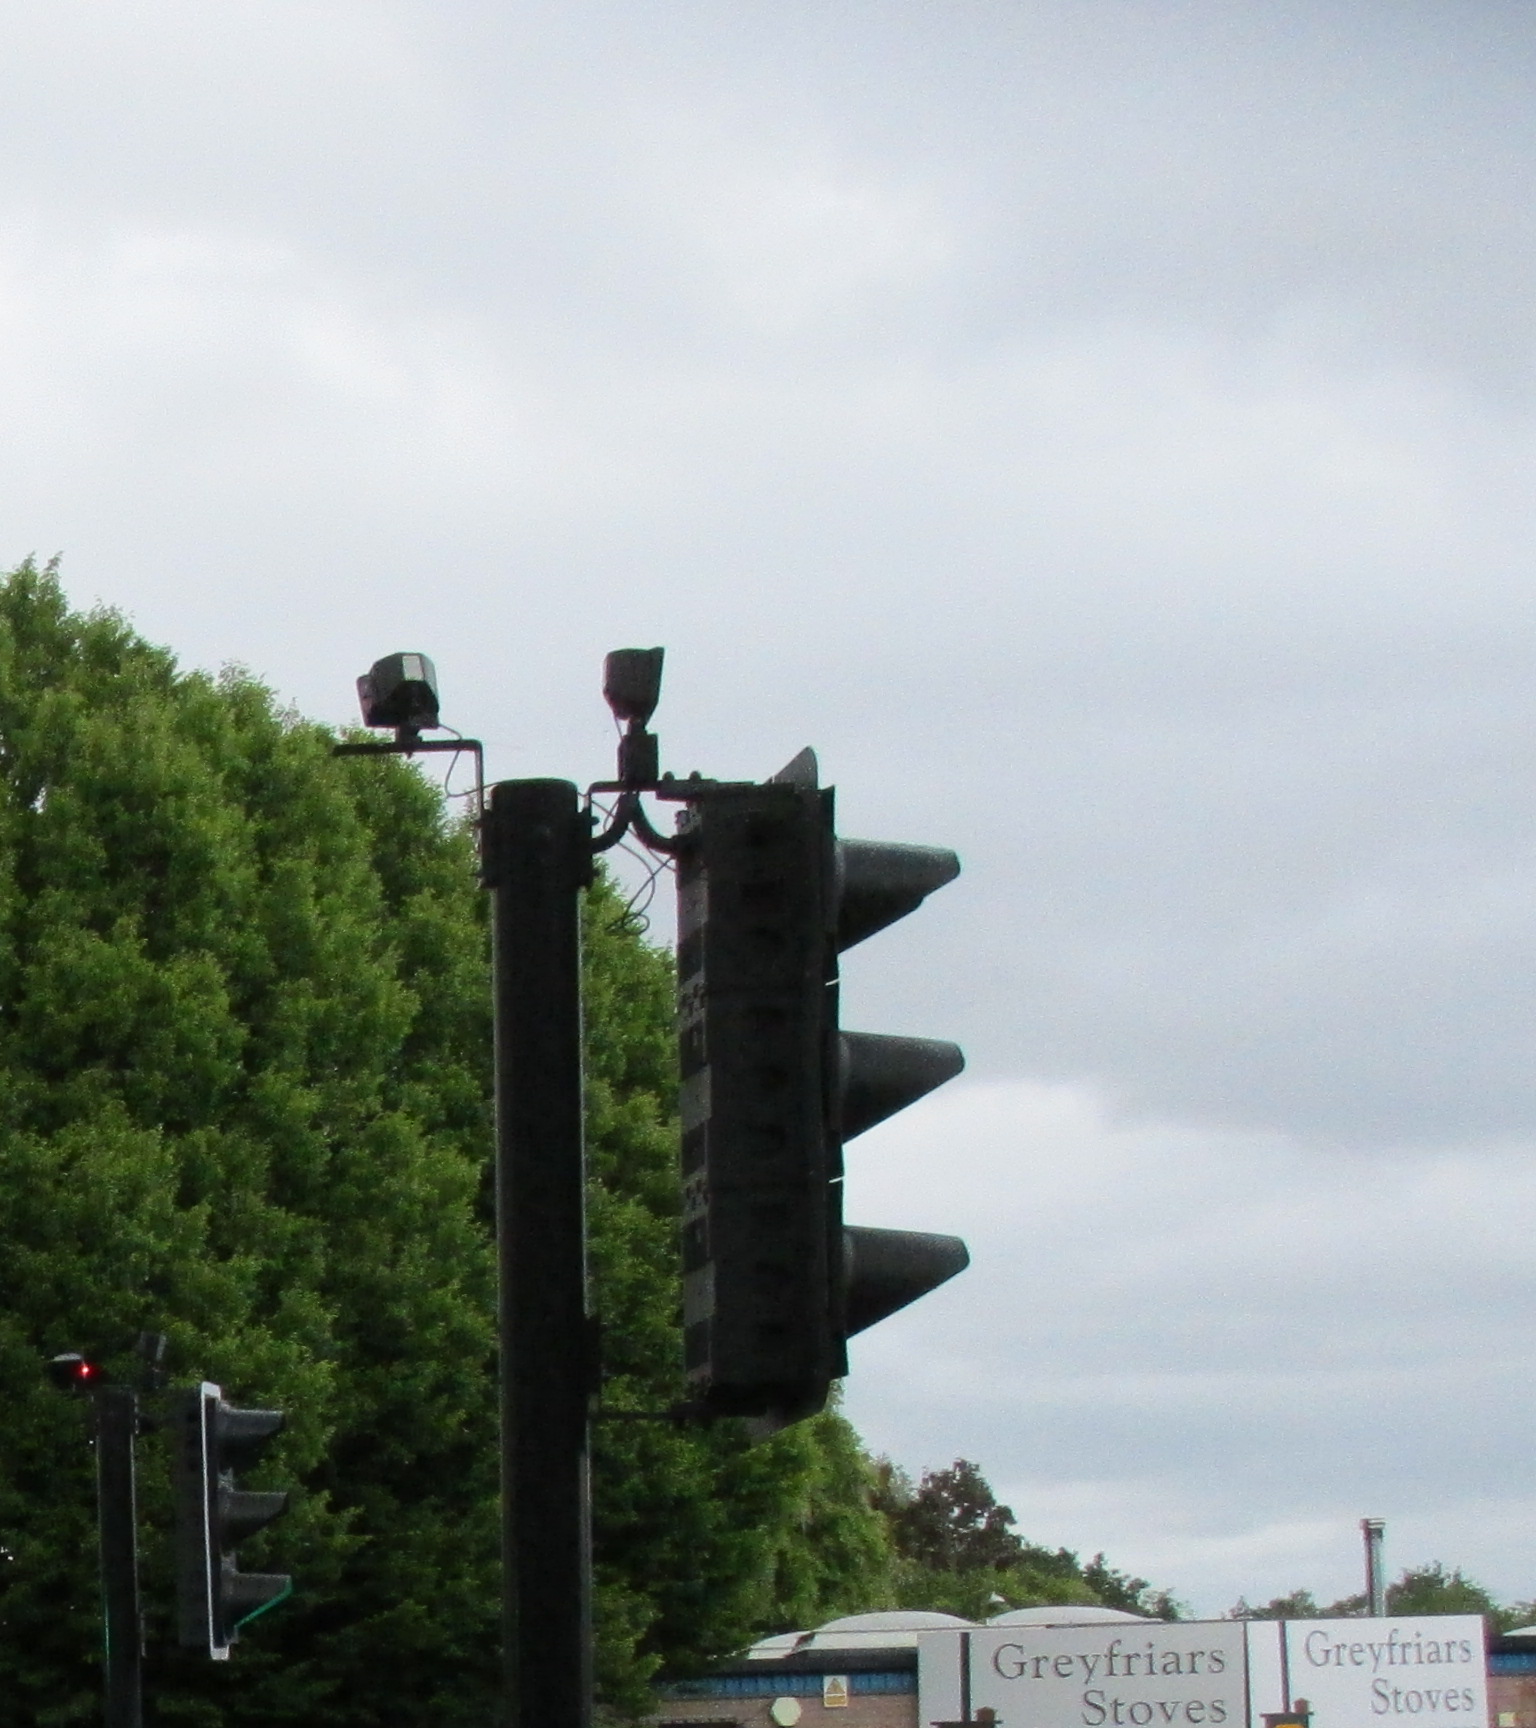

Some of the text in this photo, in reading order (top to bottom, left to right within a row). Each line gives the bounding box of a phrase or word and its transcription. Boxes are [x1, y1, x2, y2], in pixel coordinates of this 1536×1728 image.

[993, 1639, 1226, 1684] Greyfriars
[1305, 1628, 1472, 1673] Greyfriars
[1081, 1689, 1228, 1726] Stoves
[1370, 1677, 1475, 1715] Stoves
